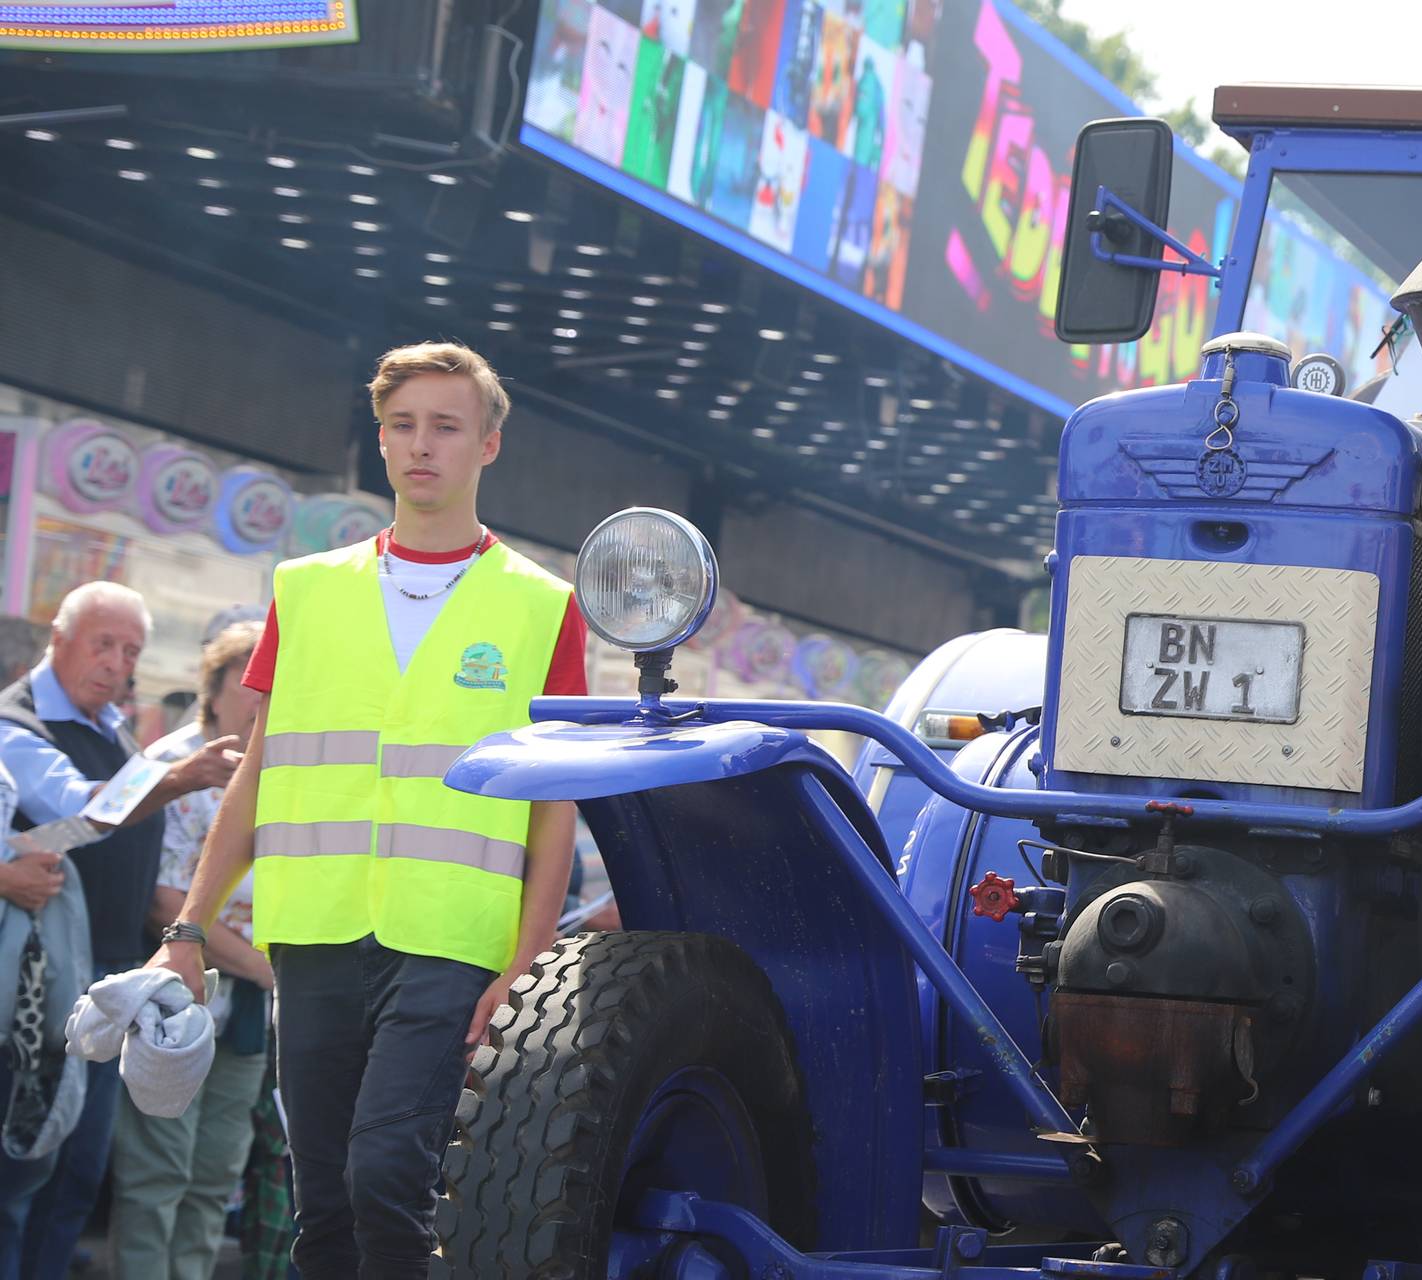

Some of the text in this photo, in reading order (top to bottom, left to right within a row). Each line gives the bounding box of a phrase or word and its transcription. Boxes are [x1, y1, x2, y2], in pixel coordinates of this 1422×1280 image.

[1159, 623, 1216, 664] BN
[1151, 668, 1255, 714] ZW 1
